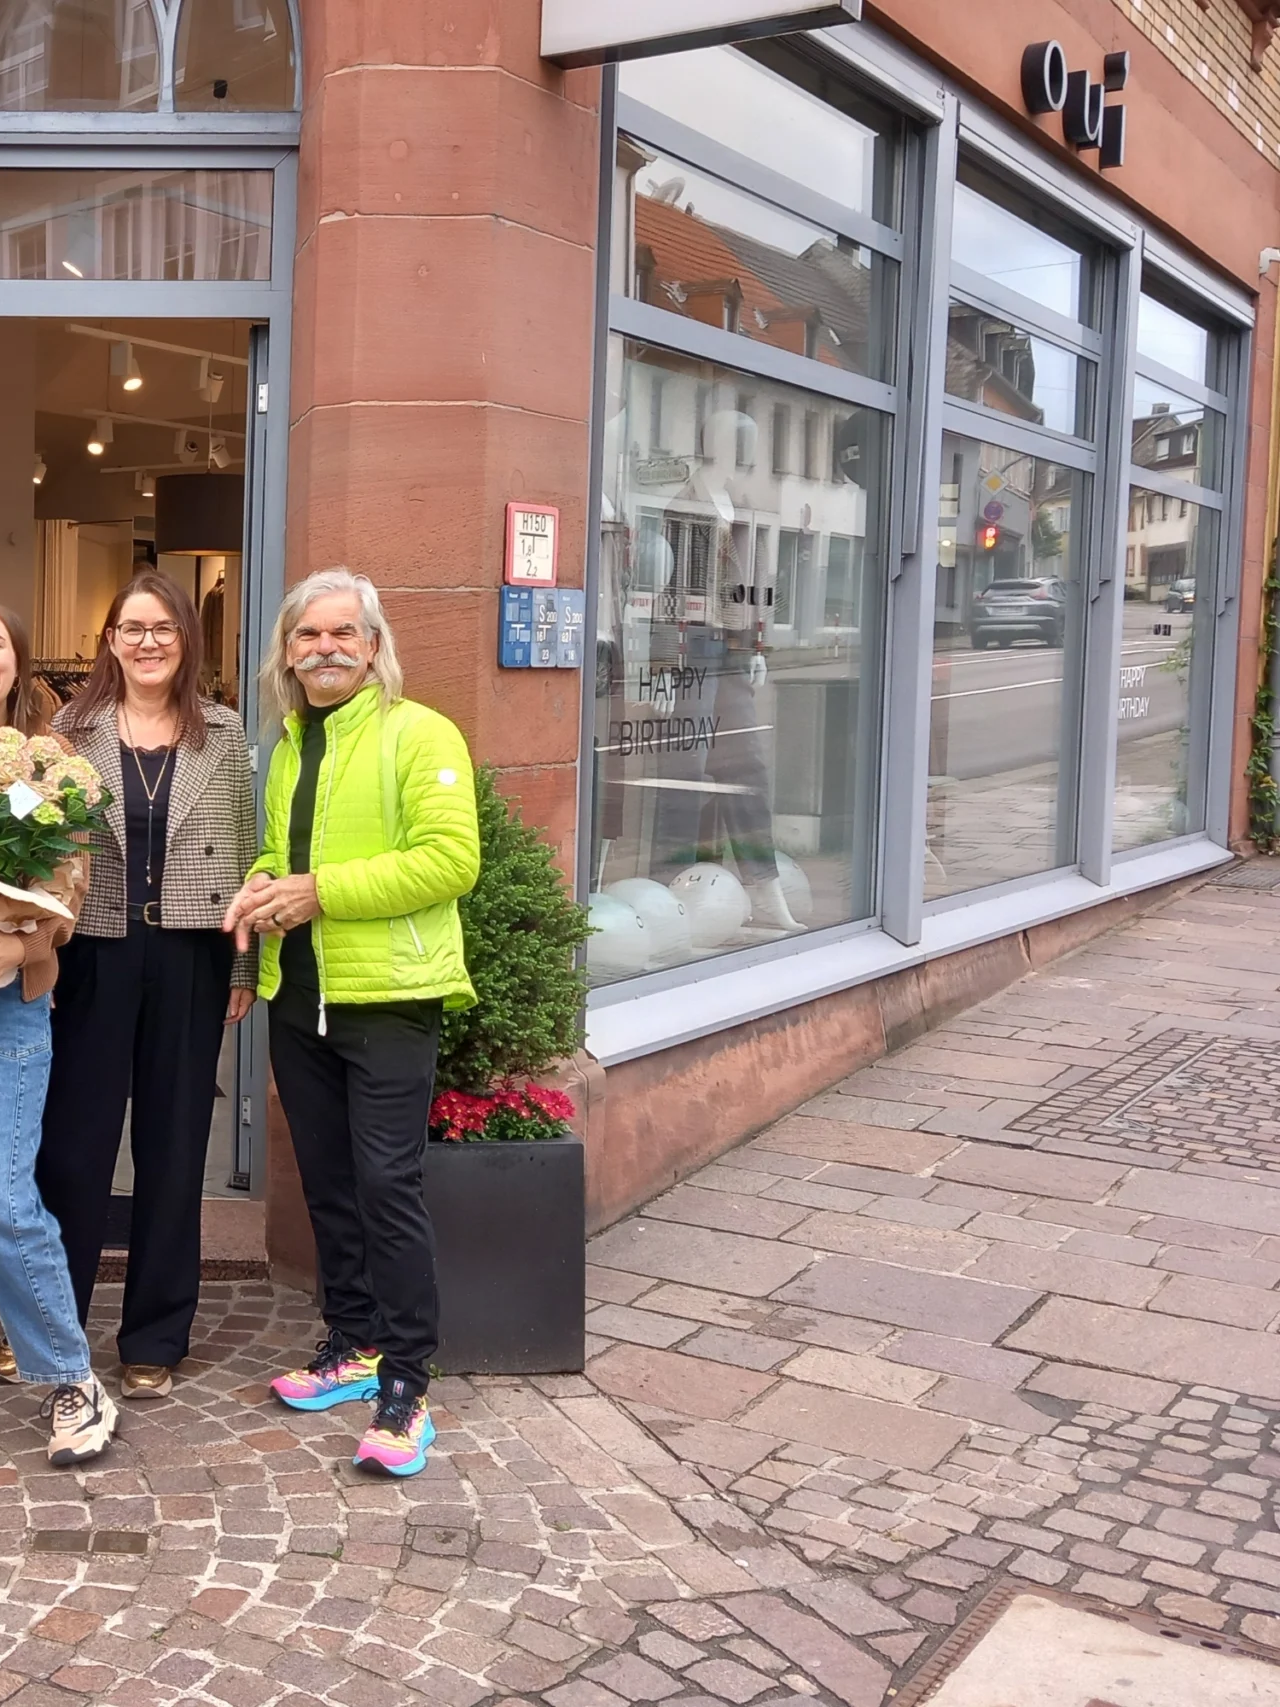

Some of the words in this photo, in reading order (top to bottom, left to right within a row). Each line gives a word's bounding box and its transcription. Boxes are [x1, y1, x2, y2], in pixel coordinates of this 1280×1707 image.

[521, 513, 547, 532] H150
[638, 666, 708, 702] HAPPY
[620, 716, 721, 757] BIRTHDAY
